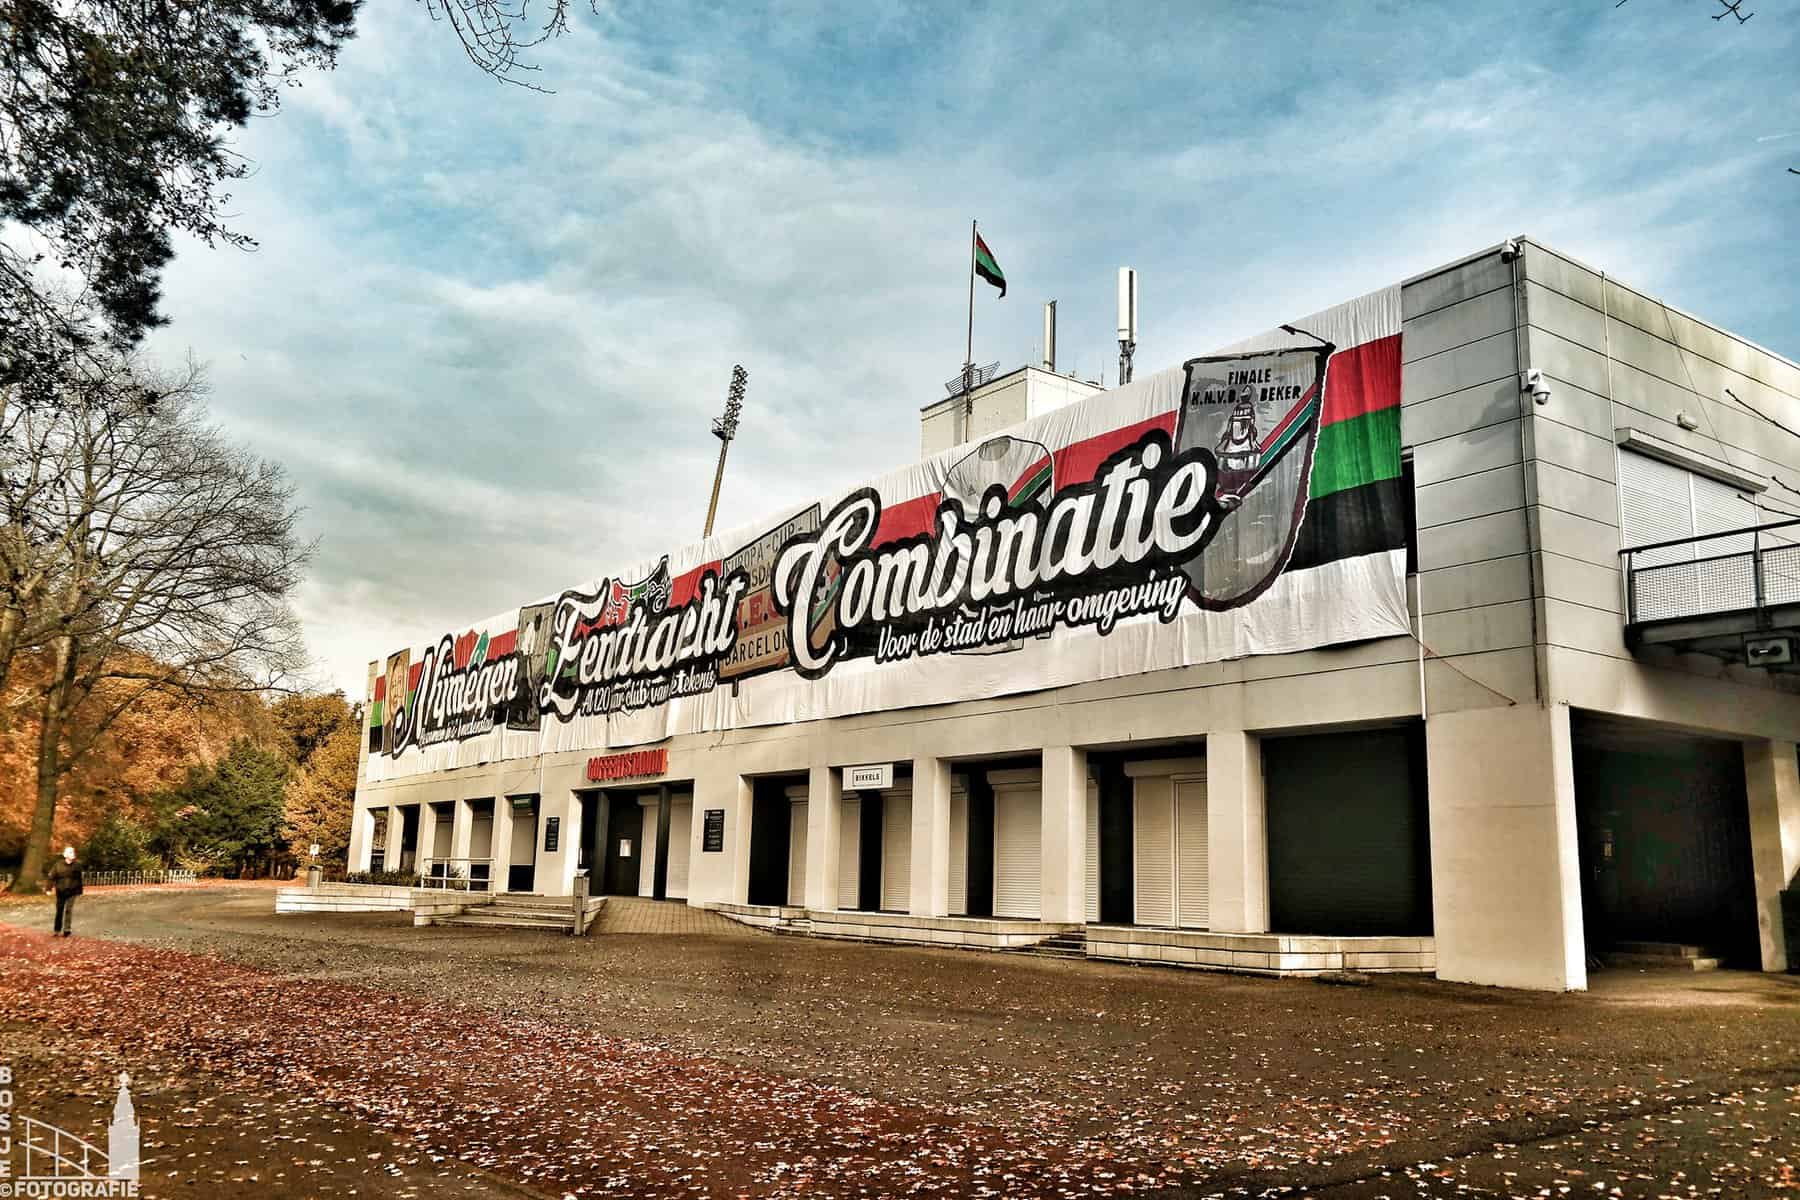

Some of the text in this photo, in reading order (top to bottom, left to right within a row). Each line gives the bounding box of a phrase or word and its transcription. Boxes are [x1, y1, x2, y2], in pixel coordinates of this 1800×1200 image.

[1228, 368, 1272, 385] FINALE
[1260, 385, 1302, 402] BEKER
[777, 443, 1211, 668] Combinatie
[540, 577, 746, 715] Eendracht
[878, 568, 1187, 659] Voor de stad en haar omgeving
[393, 638, 518, 756] Nijmegen
[625, 678, 649, 707] club
